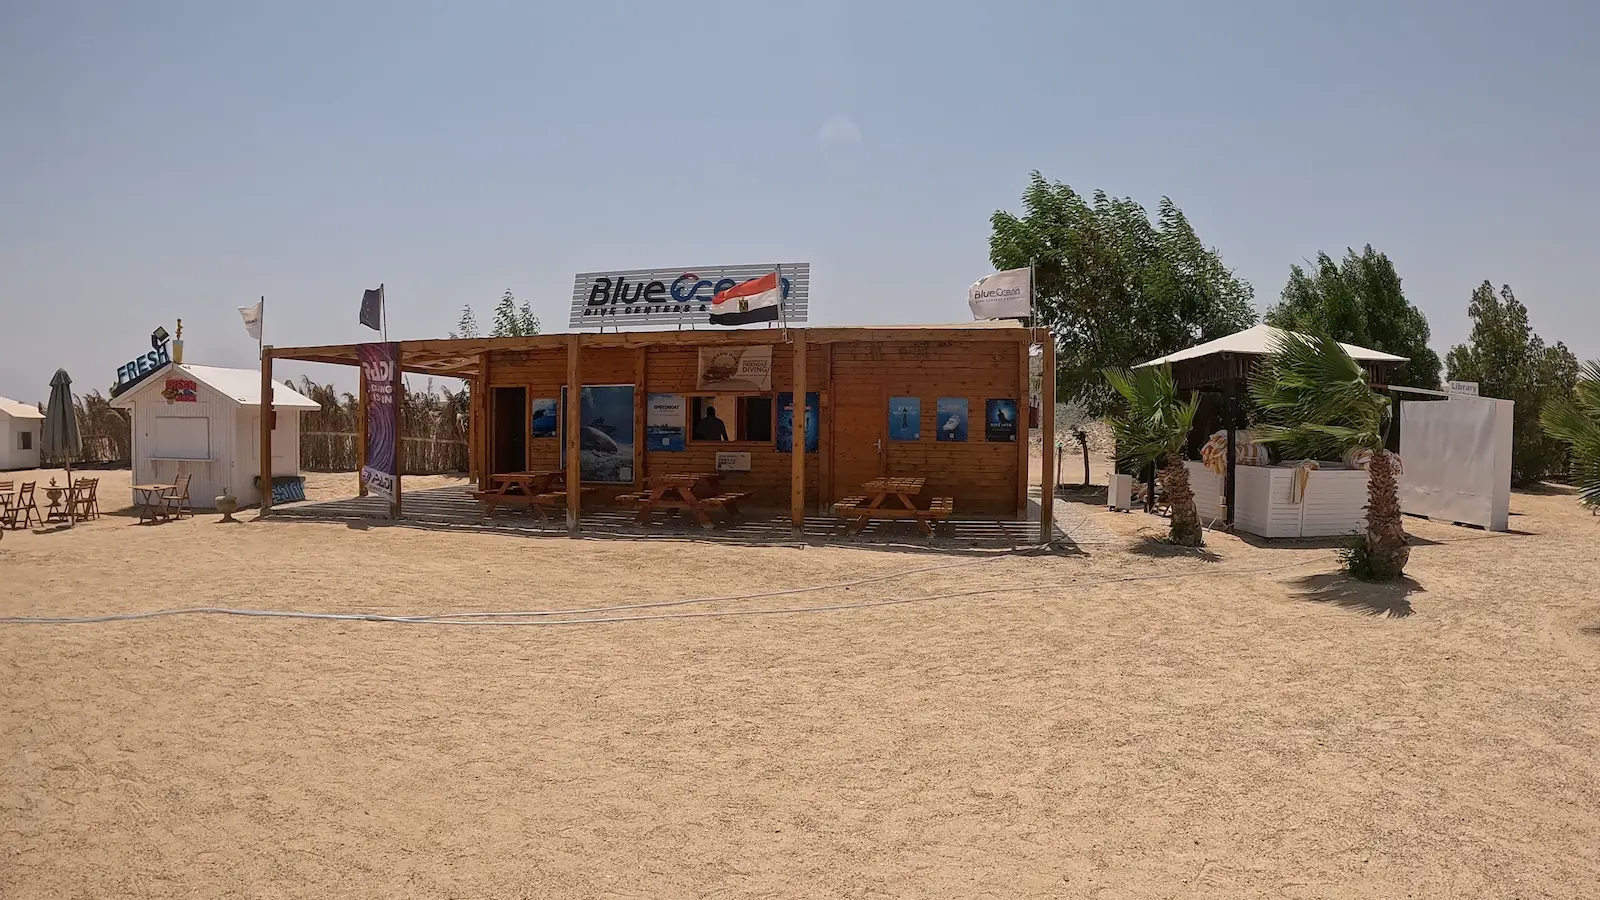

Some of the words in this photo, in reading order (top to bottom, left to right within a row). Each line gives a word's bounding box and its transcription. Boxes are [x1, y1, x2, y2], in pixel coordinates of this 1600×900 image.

[583, 307, 616, 316] DIVE
[624, 304, 691, 315] CENTERS
[117, 343, 171, 385] FRESH
[1451, 382, 1477, 393] Library
